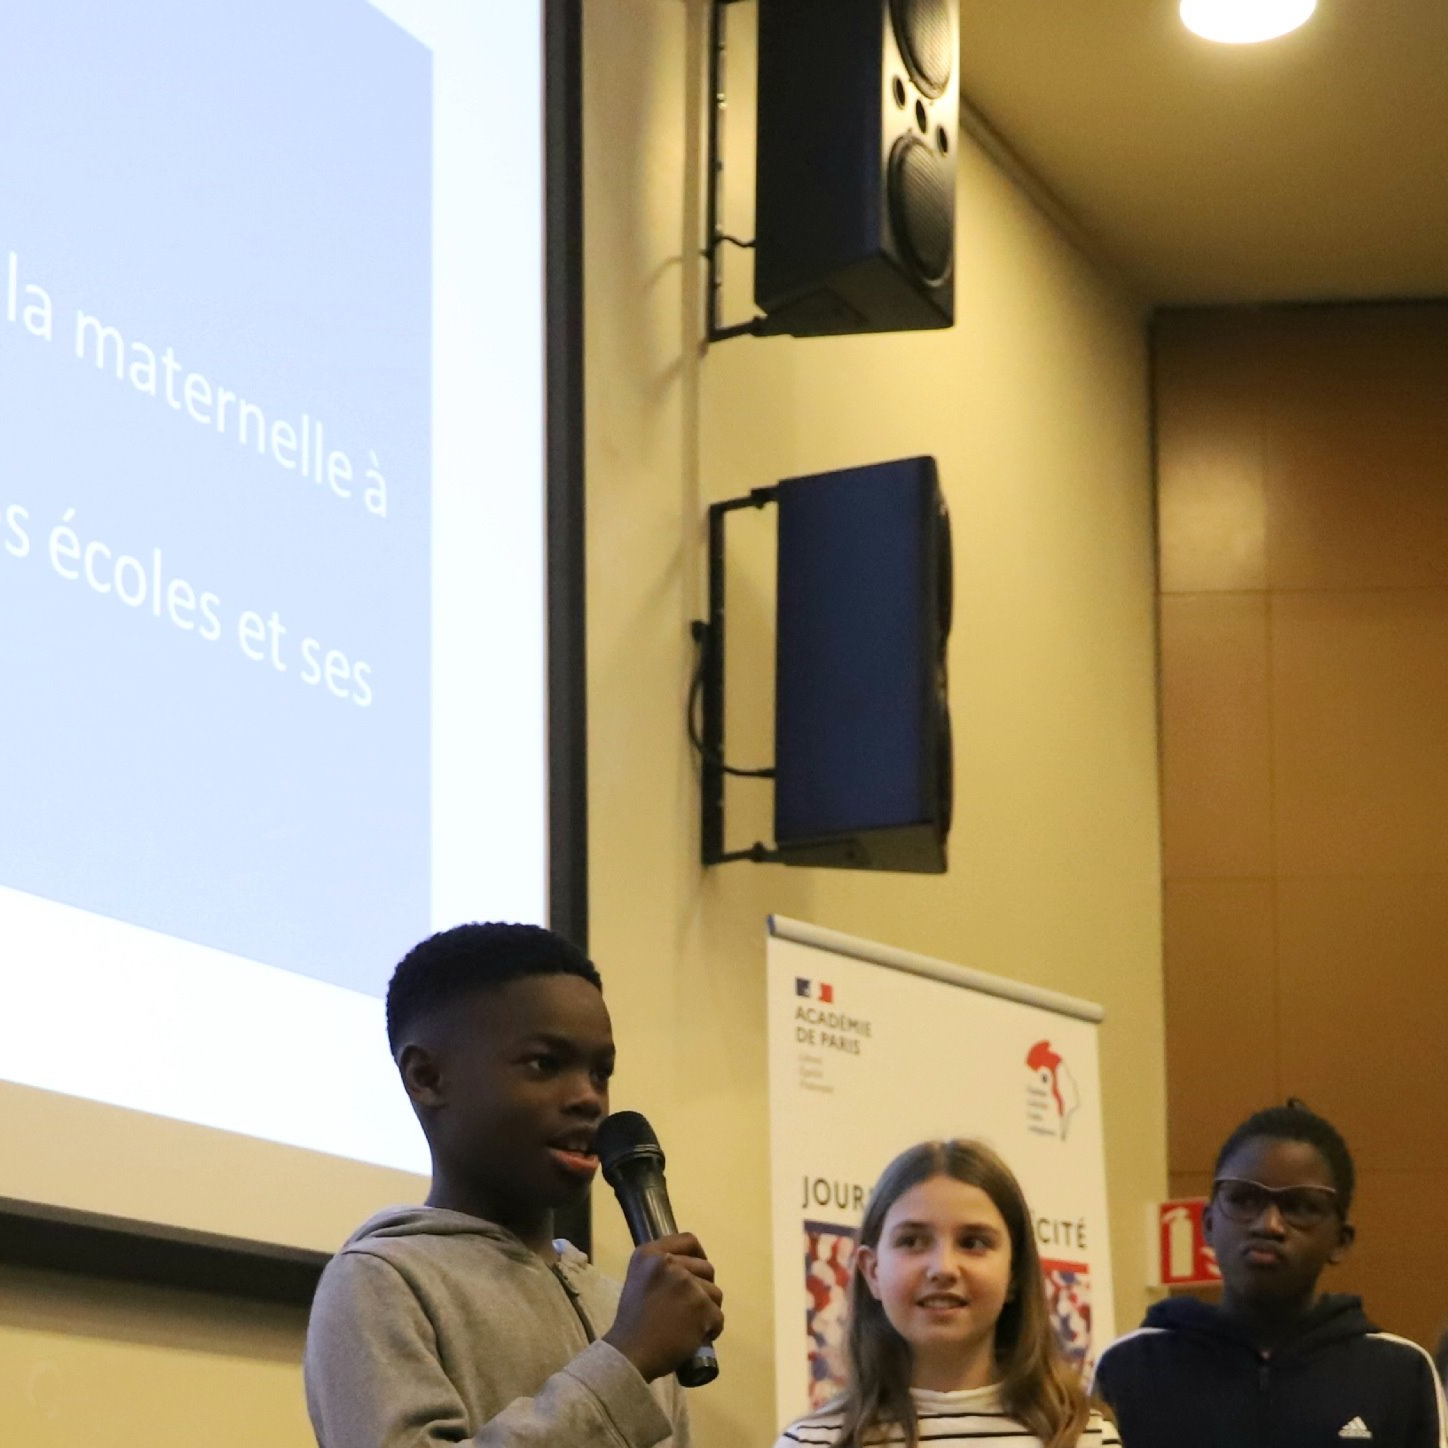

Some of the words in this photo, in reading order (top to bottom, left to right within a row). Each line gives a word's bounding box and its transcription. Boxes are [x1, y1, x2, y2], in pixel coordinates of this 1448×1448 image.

[7, 250, 52, 341] la
[75, 308, 353, 498] maternelle
[364, 449, 388, 518] à
[49, 507, 222, 642] écoles
[238, 610, 287, 672] et
[301, 637, 373, 707] ses
[795, 1006, 872, 1039] ACADÉMIE
[796, 1026, 816, 1046] DE
[821, 1031, 861, 1056] PARIS
[801, 1175, 867, 1212] JOUR
[1032, 1214, 1088, 1251] CITÉ
